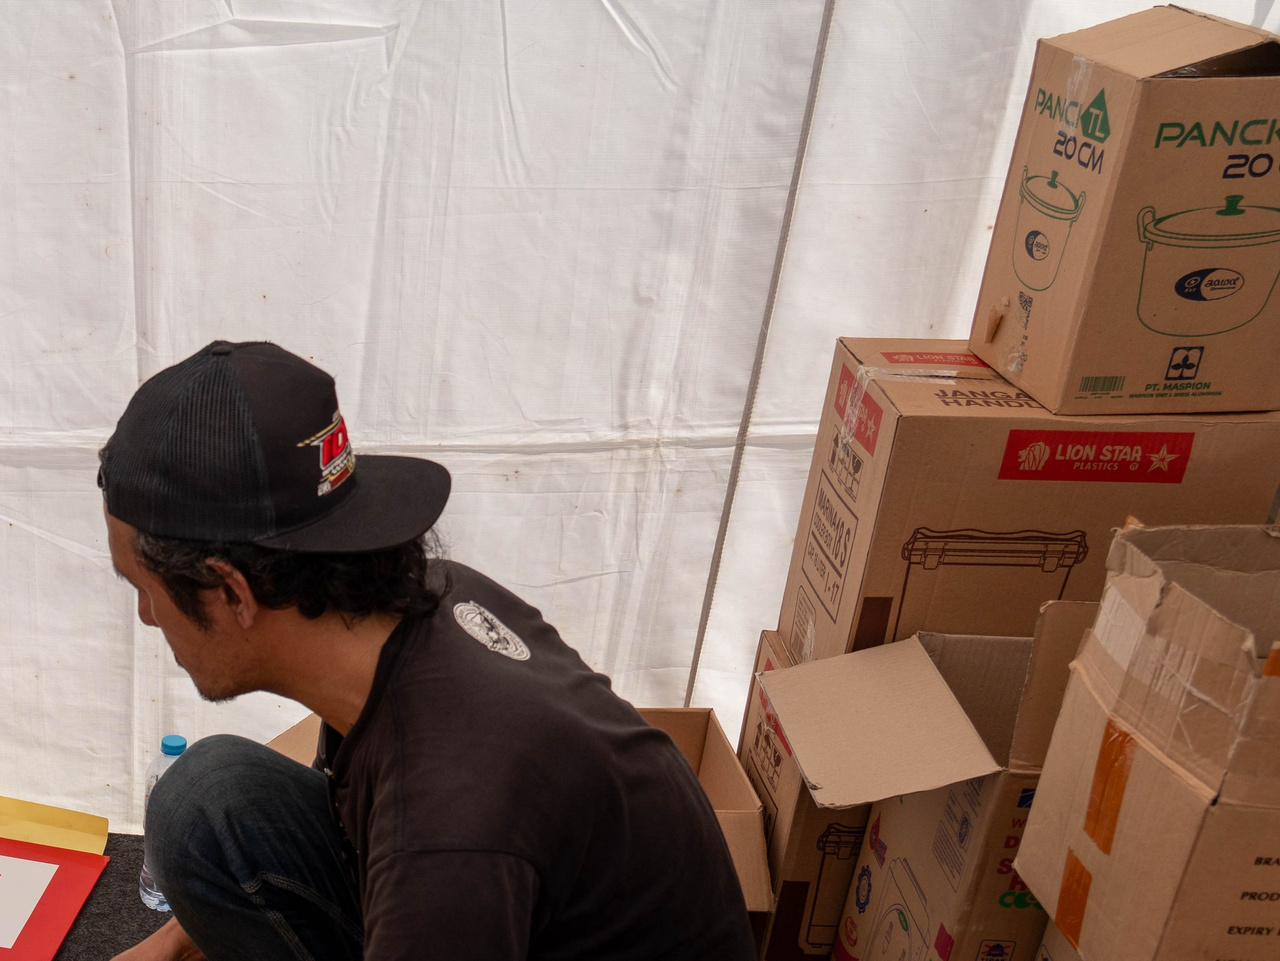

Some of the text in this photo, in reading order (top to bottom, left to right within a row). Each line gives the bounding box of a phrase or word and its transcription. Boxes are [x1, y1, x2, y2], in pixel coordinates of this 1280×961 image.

[1034, 87, 1083, 129] PANCI
[1087, 107, 1106, 139] TL
[1052, 129, 1105, 175] 20 CM
[1222, 153, 1274, 179] 20
[1145, 382, 1211, 391] PT. MASPION
[1055, 446, 1142, 462] LION STAR
[1073, 462, 1119, 470] PLASTICS
[840, 527, 850, 568] S
[1227, 926, 1274, 936] EXPIRY
